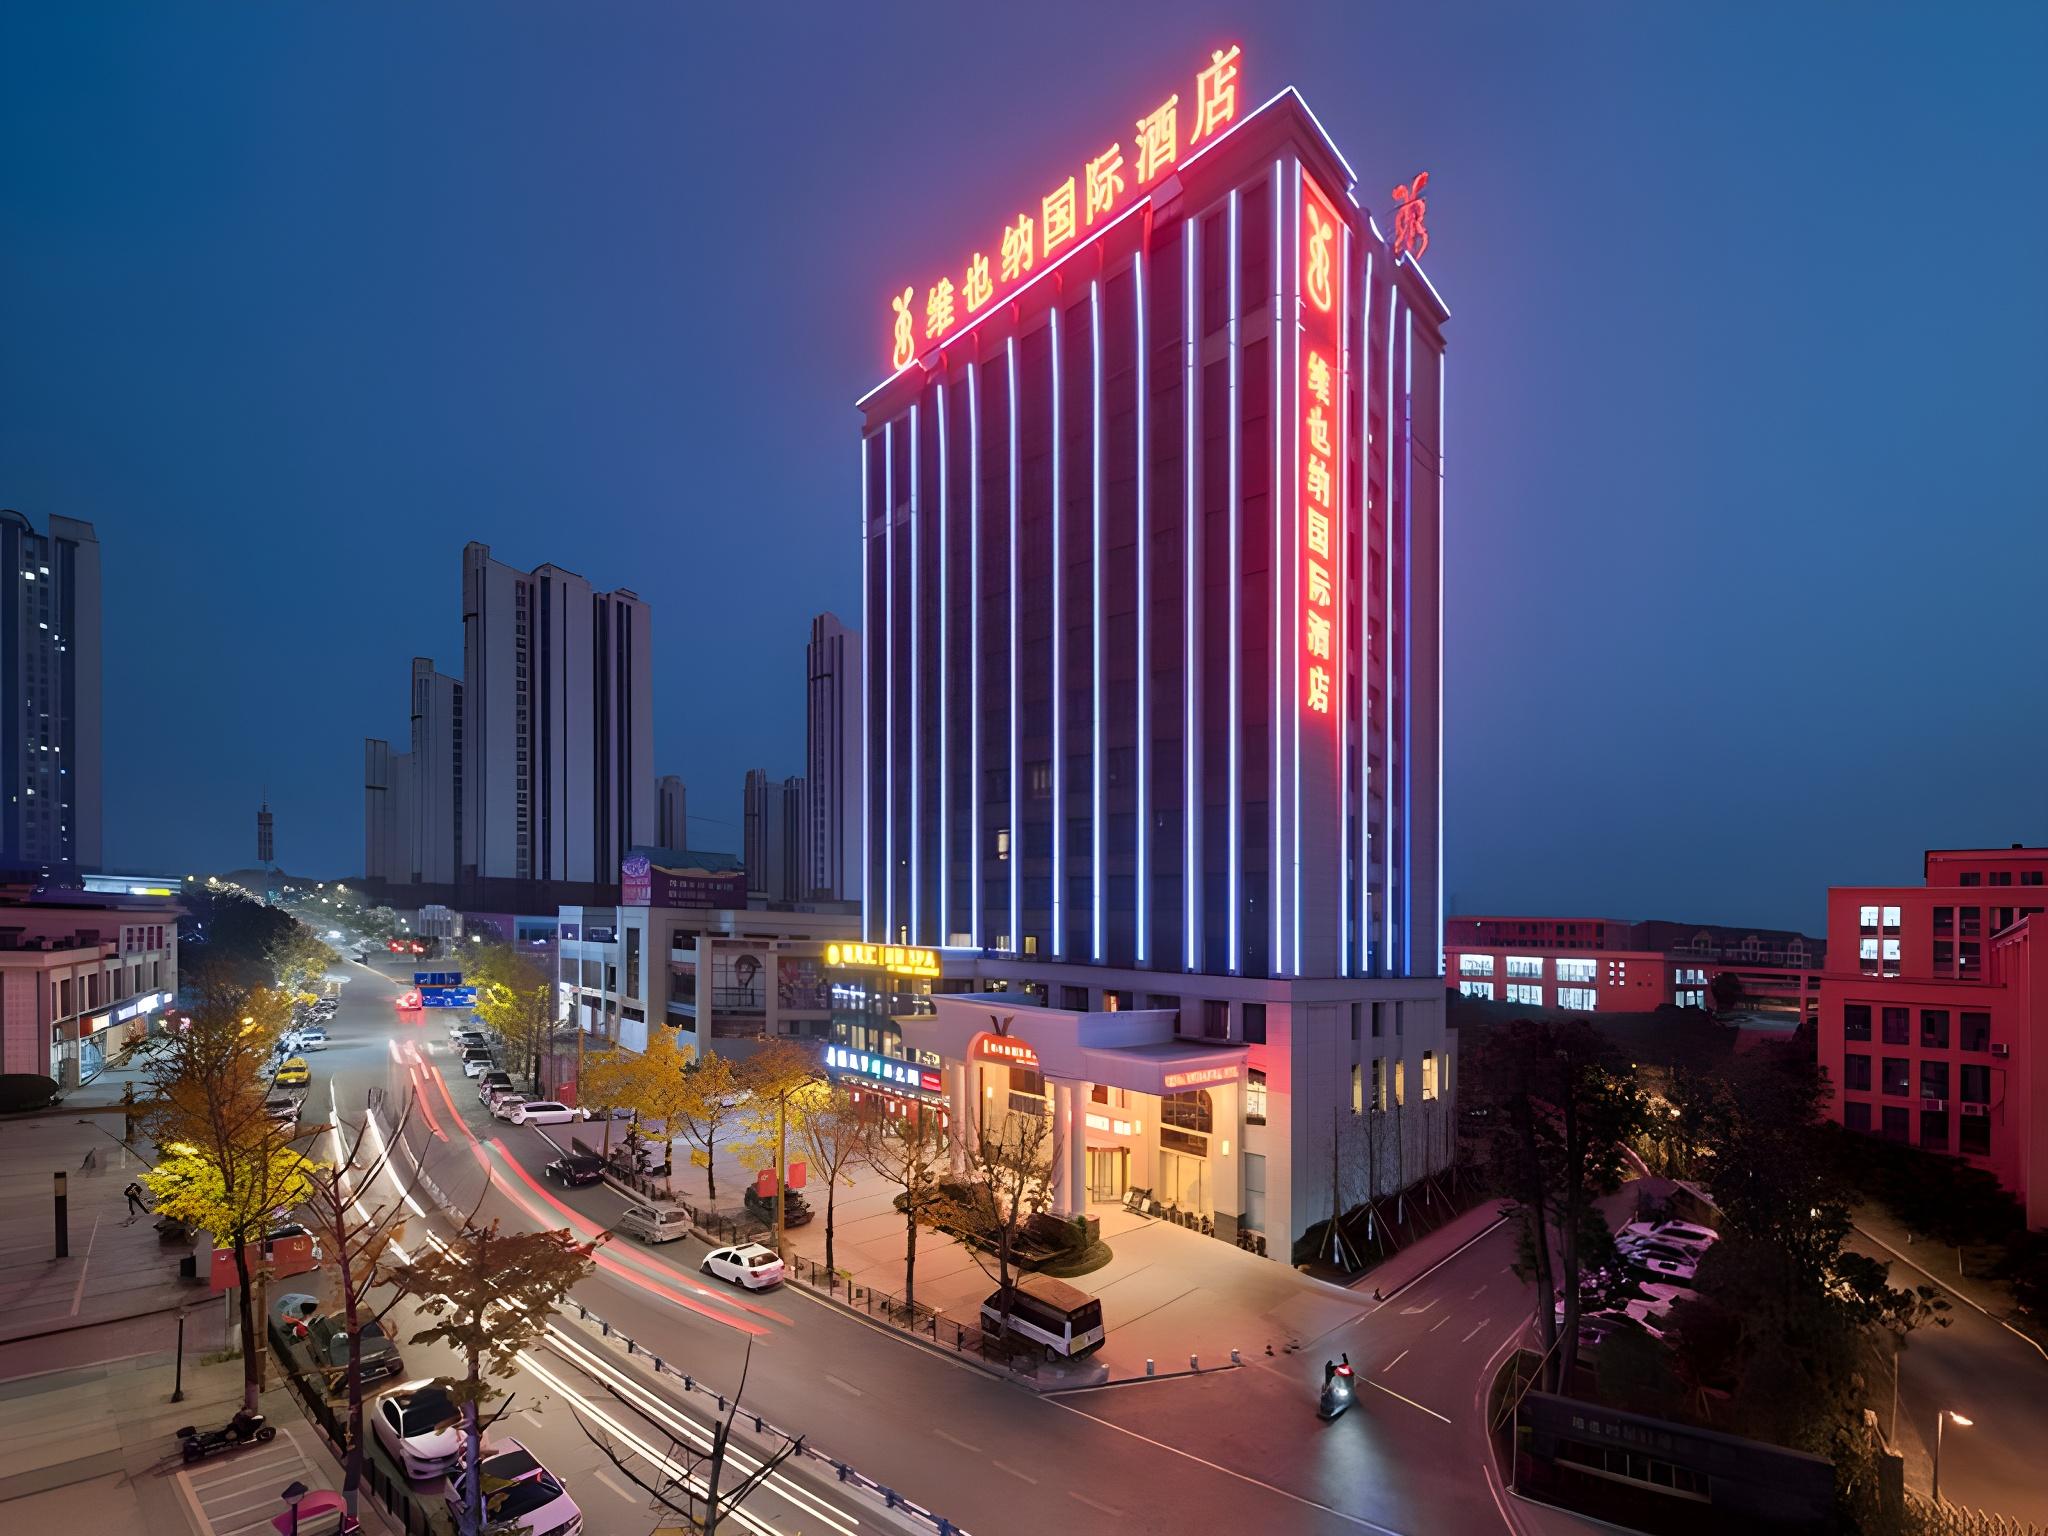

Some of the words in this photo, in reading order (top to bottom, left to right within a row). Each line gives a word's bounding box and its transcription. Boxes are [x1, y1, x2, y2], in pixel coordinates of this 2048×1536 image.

[925, 44, 1241, 340] 维也纳国际酒店
[1306, 351, 1332, 713] 维也纳国际酒店
